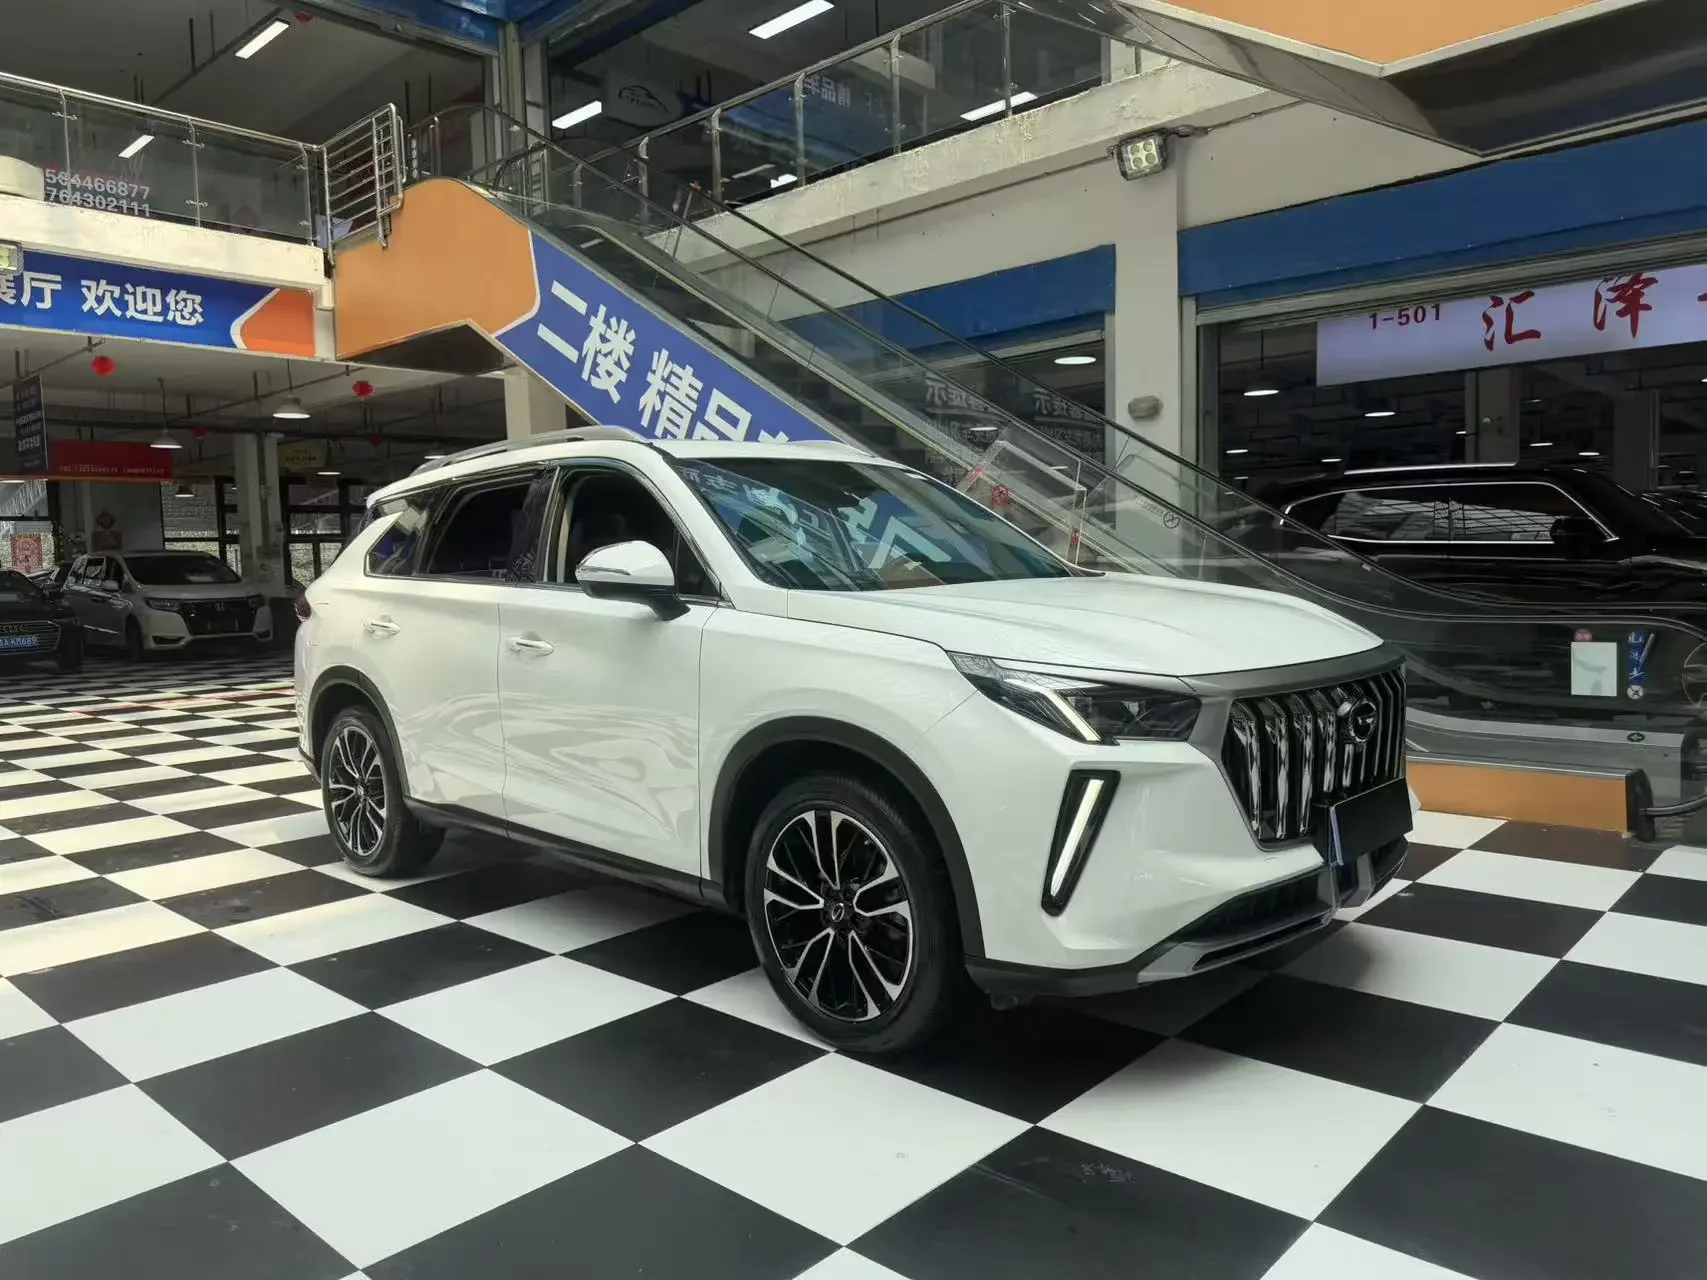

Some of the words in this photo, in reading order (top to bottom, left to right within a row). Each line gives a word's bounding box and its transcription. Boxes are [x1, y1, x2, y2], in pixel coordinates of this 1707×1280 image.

[0, 271, 62, 309] 厅
[80, 279, 204, 326] 欢迎您
[1368, 303, 1441, 330] 1-501
[537, 280, 636, 404] 二楼
[639, 348, 789, 440] 精品
